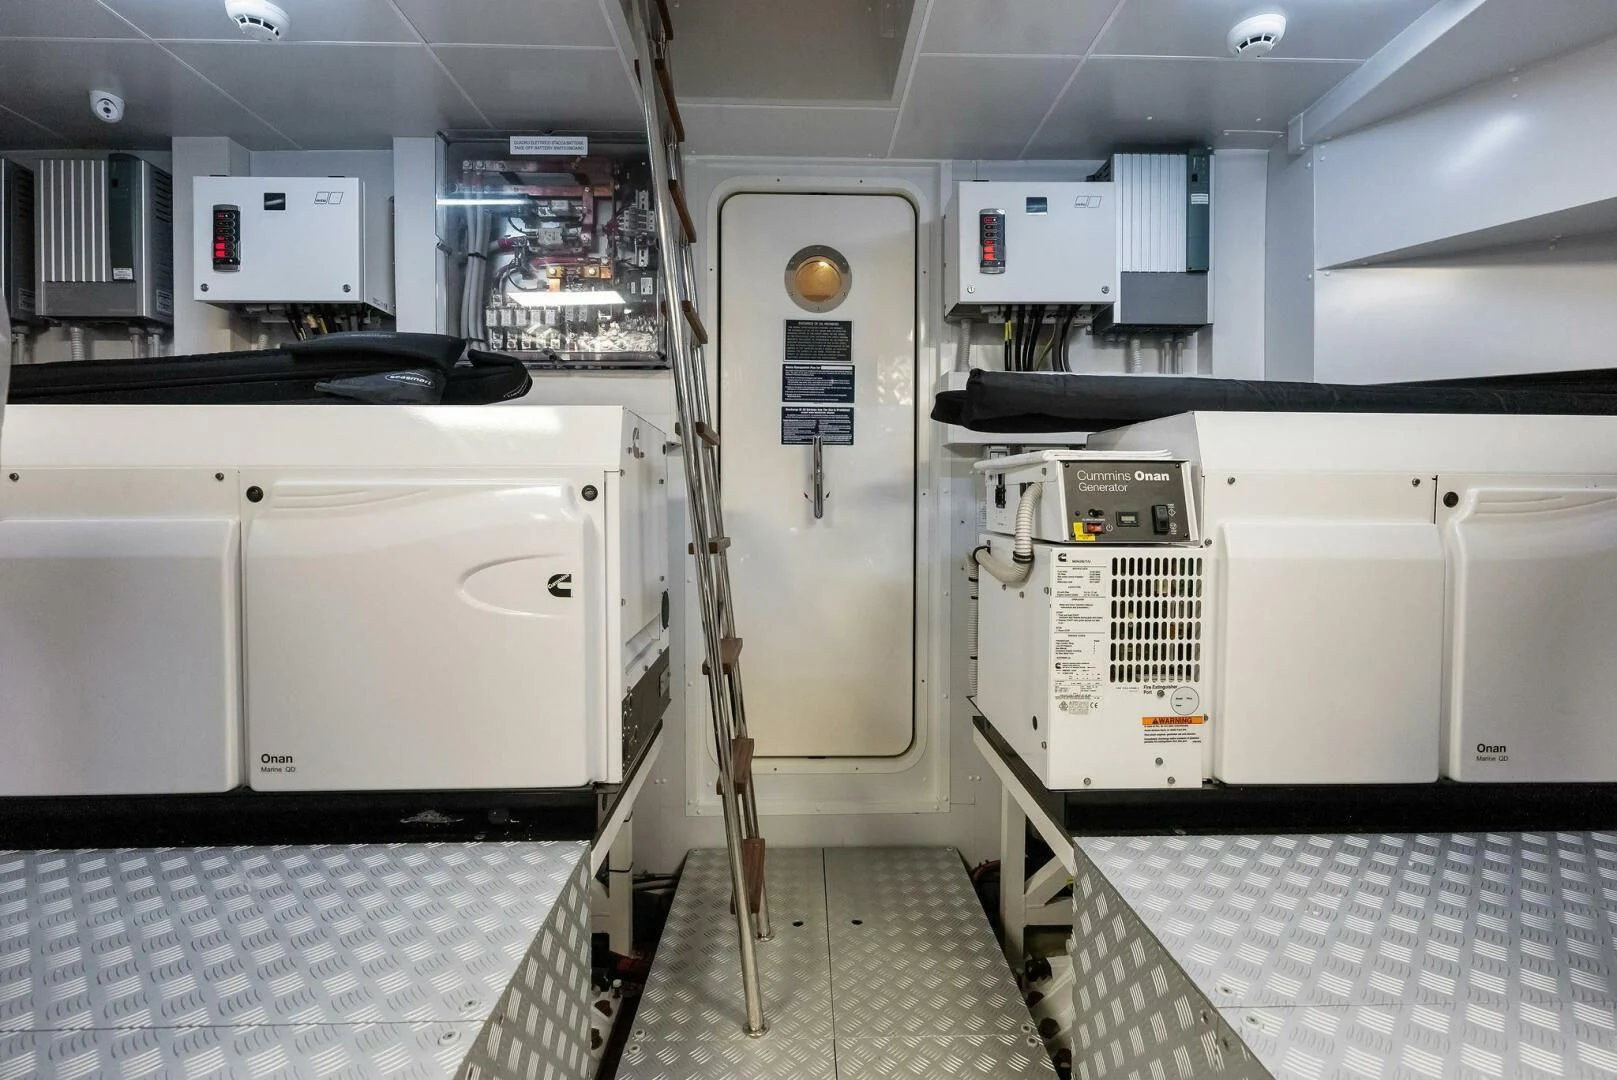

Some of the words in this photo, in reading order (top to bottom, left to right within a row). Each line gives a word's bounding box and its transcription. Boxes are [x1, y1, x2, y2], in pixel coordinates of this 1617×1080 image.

[1077, 470, 1132, 481] Cummins
[1134, 470, 1170, 481] Onan
[1078, 482, 1129, 492] Generator
[1477, 743, 1506, 753] Onan
[261, 753, 293, 764] Onan
